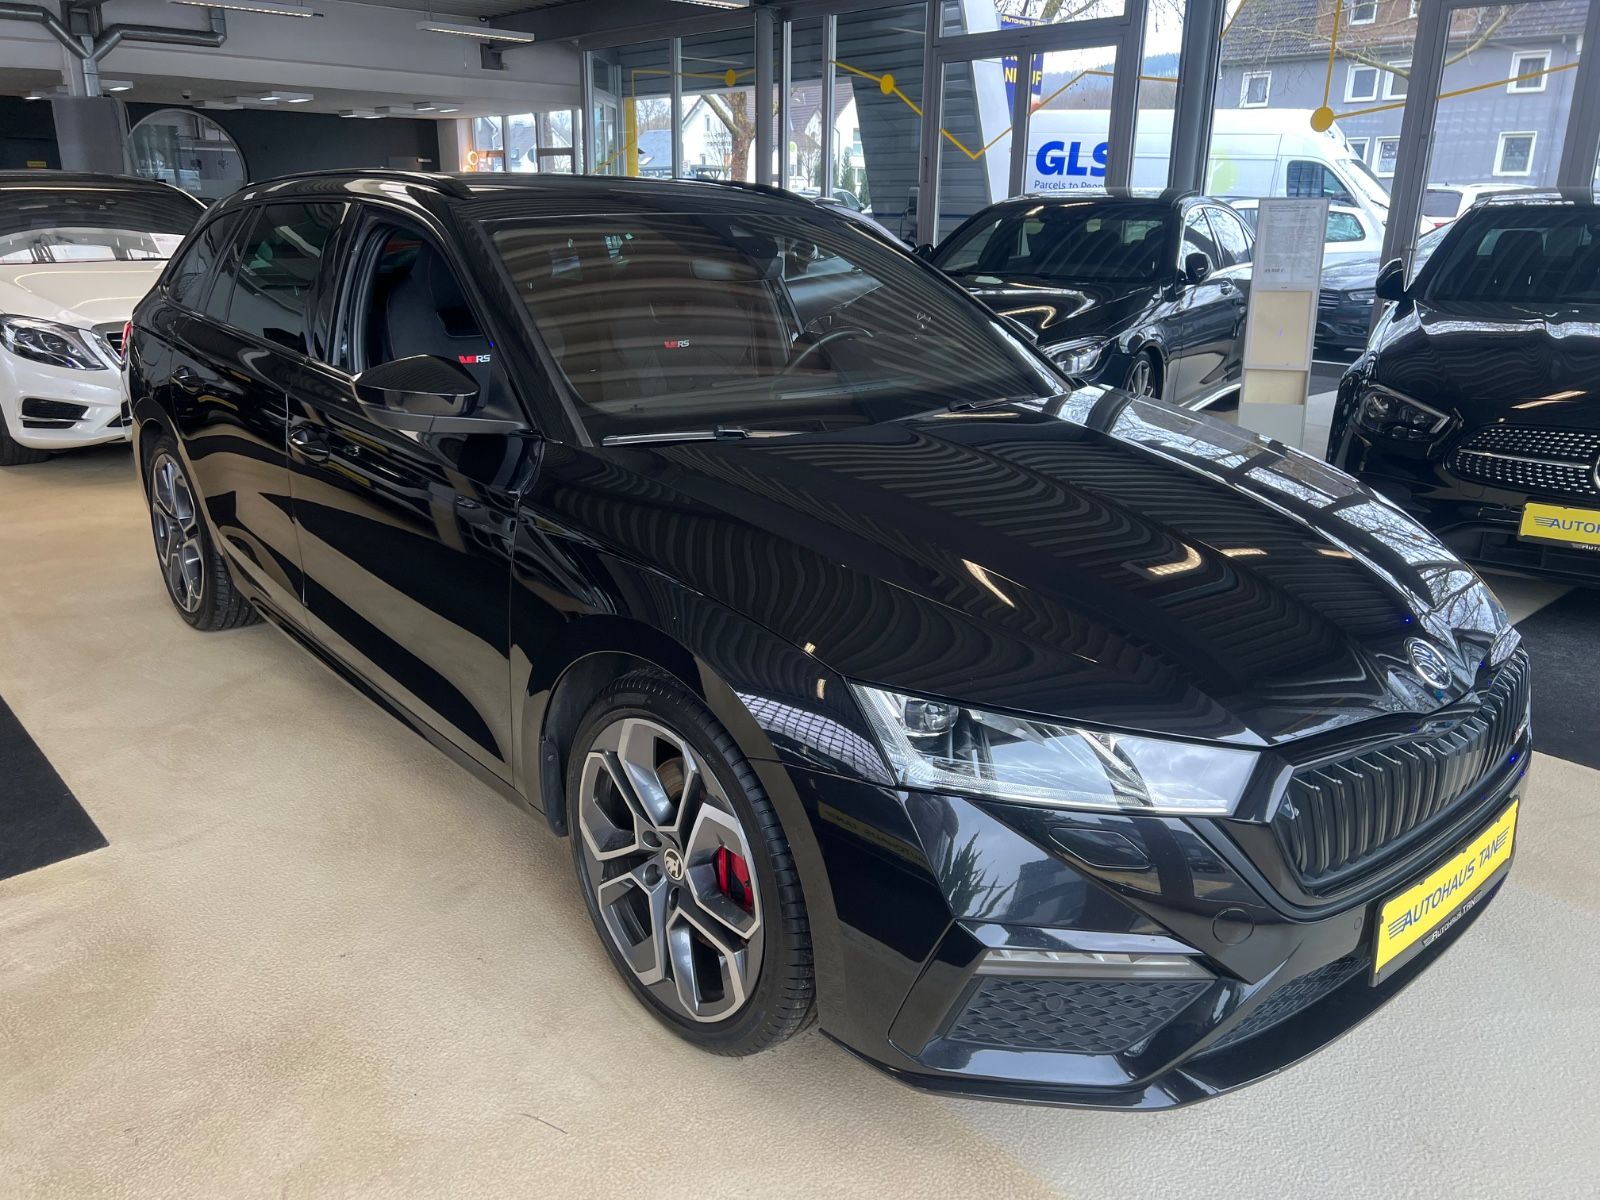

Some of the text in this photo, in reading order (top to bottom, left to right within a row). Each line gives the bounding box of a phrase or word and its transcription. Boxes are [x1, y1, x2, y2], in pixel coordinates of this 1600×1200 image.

[1036, 141, 1108, 177] GLS
[1034, 180, 1066, 190] Parcels
[1402, 835, 1501, 932] AUTOHAUS TAN
